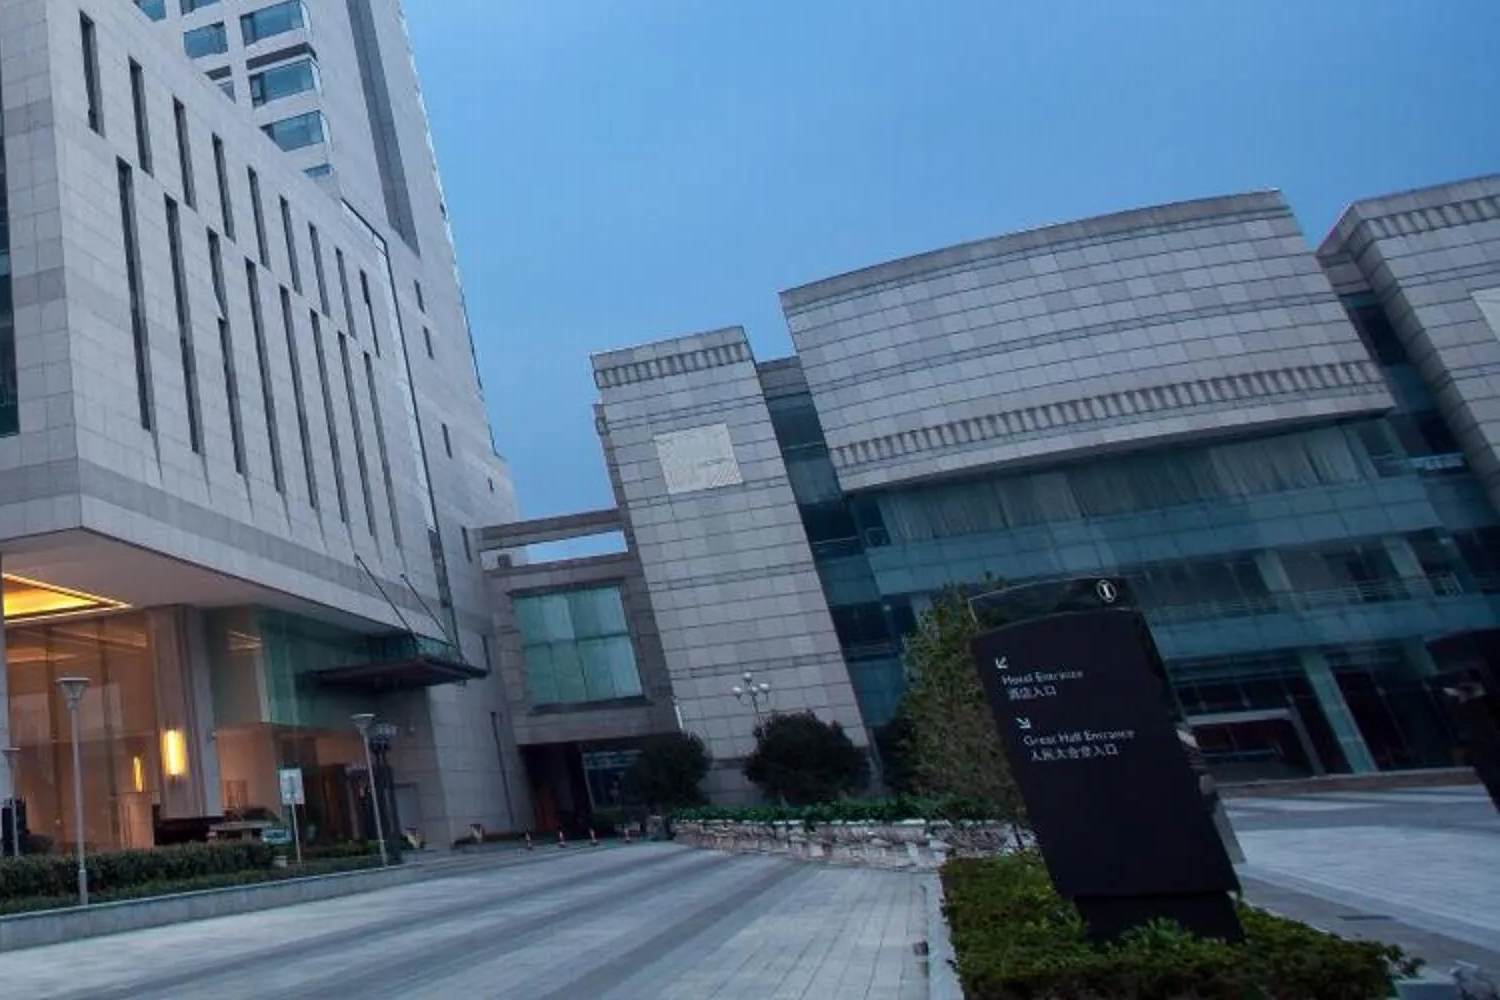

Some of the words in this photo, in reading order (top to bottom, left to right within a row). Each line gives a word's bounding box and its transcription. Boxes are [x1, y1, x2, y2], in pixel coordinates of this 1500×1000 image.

[1001, 672, 1033, 686] Hotel
[1035, 670, 1084, 682] Entrance
[1022, 733, 1057, 747] Great
[1057, 730, 1082, 744] Hall
[1083, 728, 1136, 742] Entrance
